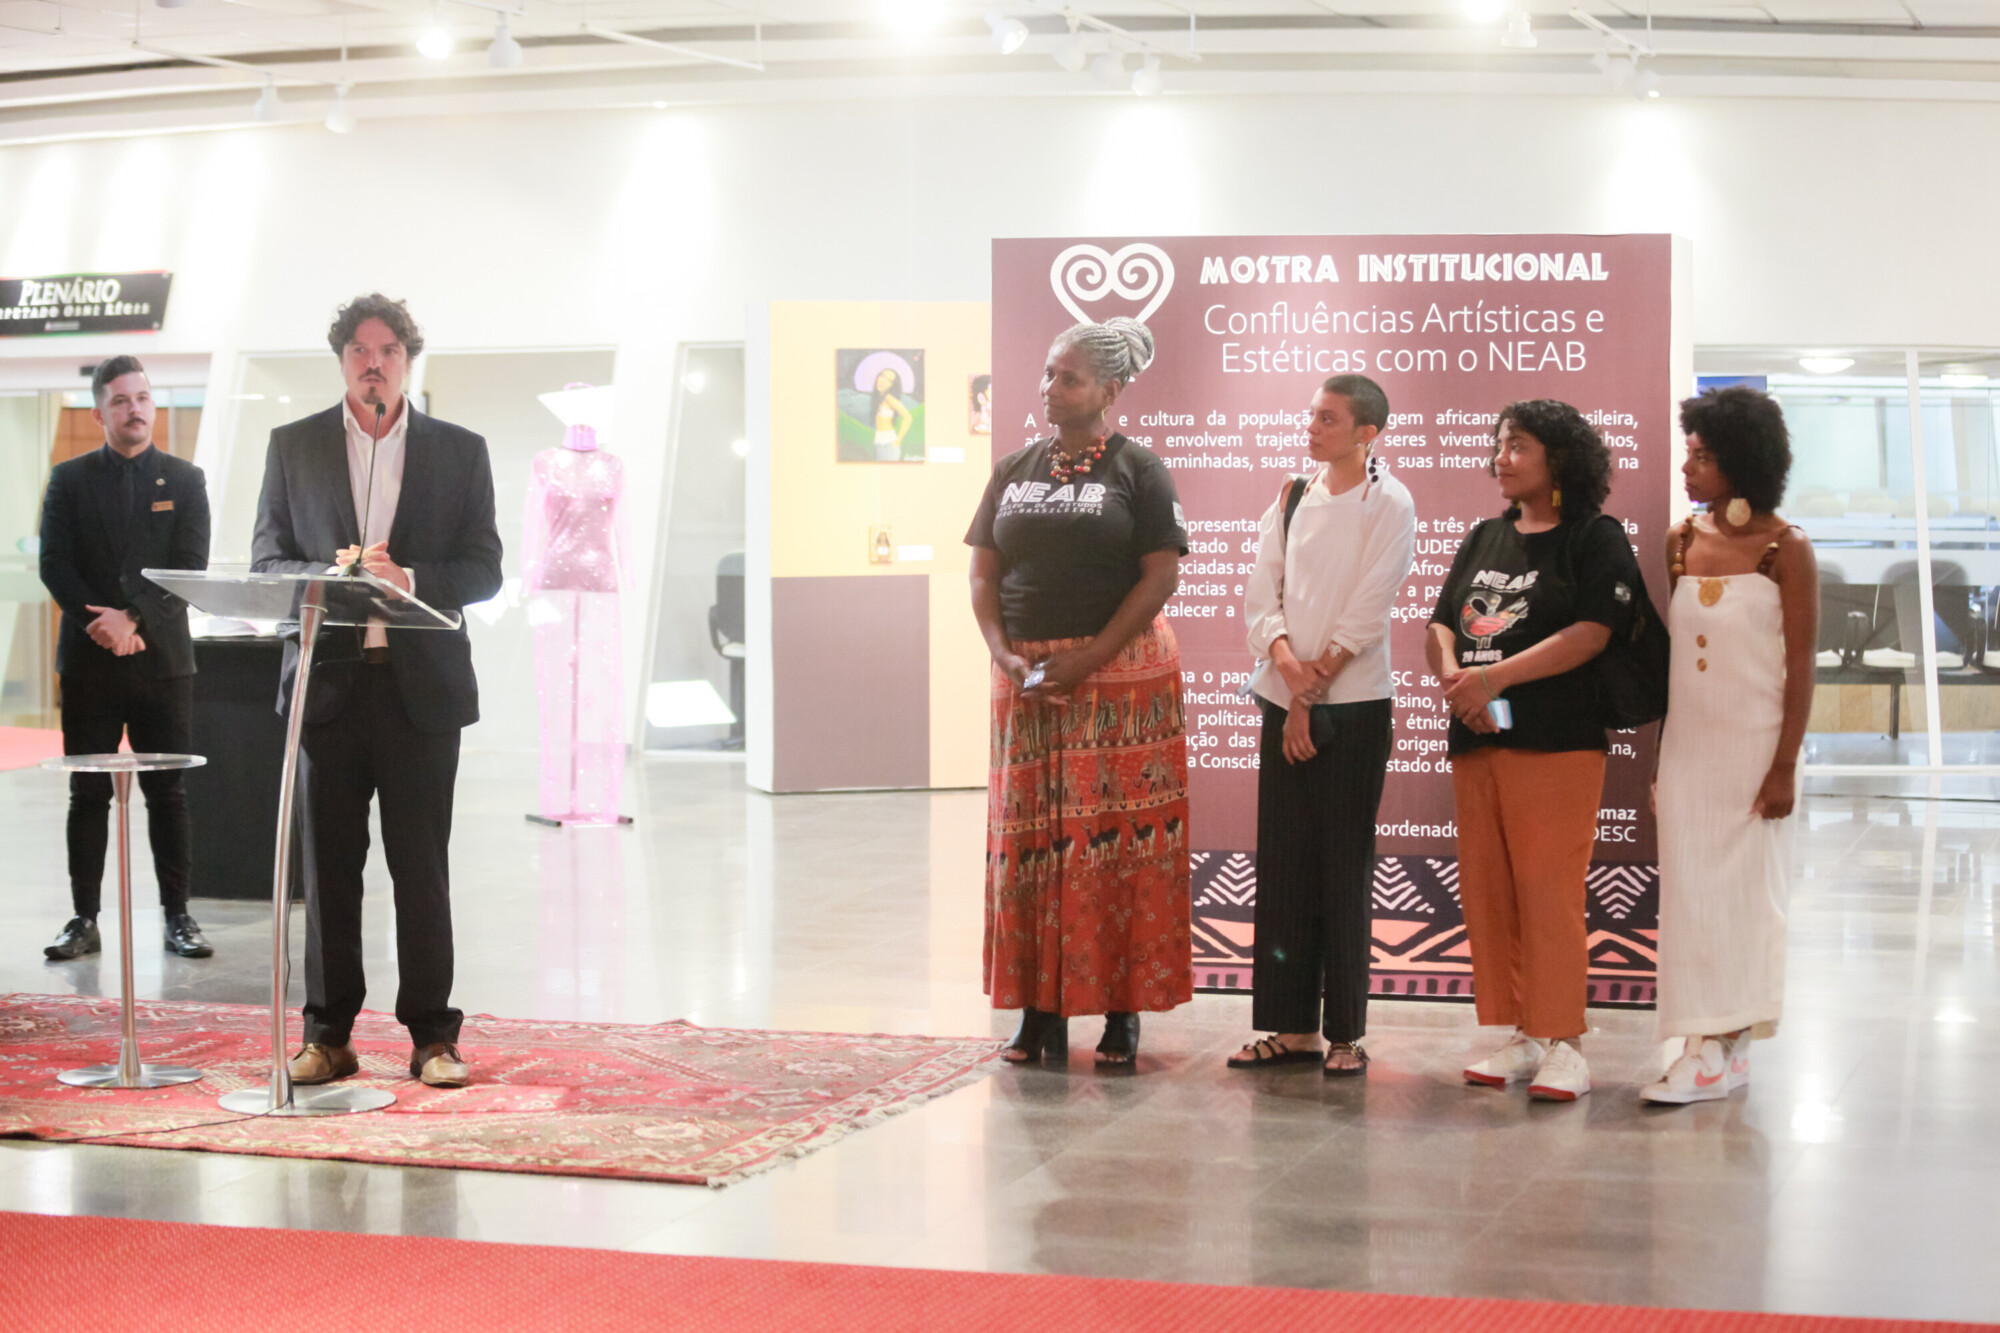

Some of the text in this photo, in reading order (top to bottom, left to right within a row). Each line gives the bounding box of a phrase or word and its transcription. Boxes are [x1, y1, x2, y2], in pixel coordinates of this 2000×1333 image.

[1200, 253, 1609, 284] MOSTRA INSTITUCIONAL
[18, 277, 121, 306] PLENÁRIO
[1204, 299, 1604, 335] Confluências Artísticas e
[1222, 339, 1586, 373] Estéticas com o NEAB
[1024, 413, 1037, 428] A
[1118, 415, 1128, 427] e
[1140, 410, 1195, 427] cultura
[1206, 409, 1226, 426] da
[1238, 409, 1311, 430] populaçã
[1387, 412, 1423, 430] gem
[1165, 431, 1243, 447] envolvem
[1255, 431, 1310, 451] trajetó
[1384, 434, 1427, 447] seres
[1439, 432, 1496, 447] vivente
[1260, 456, 1296, 469] suas
[1397, 456, 1434, 469] suas
[1618, 457, 1640, 470] na
[1001, 481, 1107, 506] NEAB
[1432, 516, 1465, 533] três
[1188, 537, 1229, 554] stado
[1178, 558, 1234, 575] ociadas
[1408, 559, 1452, 576] Afro-
[1173, 579, 1228, 596] ências
[1234, 584, 1244, 596] e
[1406, 585, 1417, 597] a
[1163, 601, 1218, 618] talecer
[1225, 605, 1236, 617] a
[1203, 671, 1214, 684] o
[1390, 671, 1413, 687] SC
[1198, 710, 1263, 730] políticas
[1228, 731, 1256, 748] das
[1200, 752, 1260, 769] Consciê
[1386, 757, 1431, 773] stado
